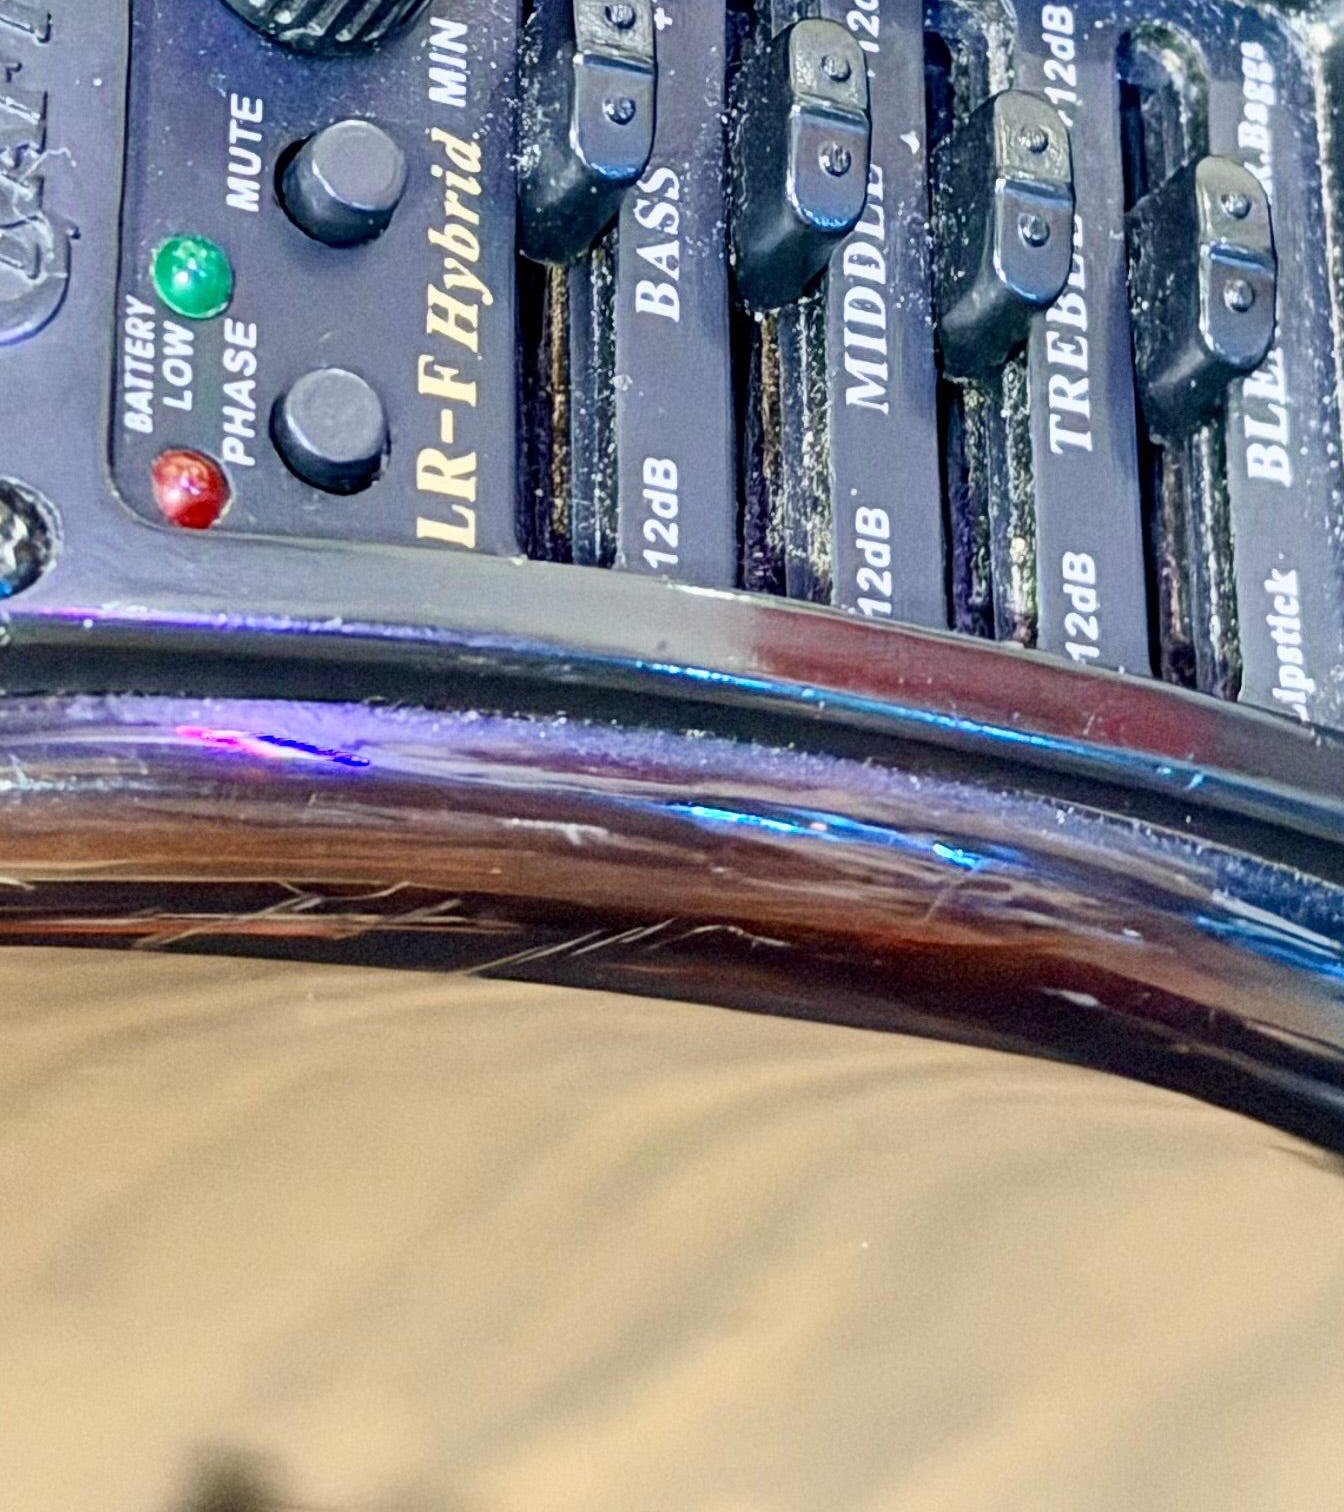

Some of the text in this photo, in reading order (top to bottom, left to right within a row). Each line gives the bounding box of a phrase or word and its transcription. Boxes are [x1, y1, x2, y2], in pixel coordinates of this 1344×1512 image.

[429, 18, 468, 107] MIN
[224, 92, 263, 214] MUTE
[636, 166, 680, 322] BASS
[122, 293, 158, 436] BATTERY
[161, 320, 195, 411] LOW
[219, 318, 258, 467] PHASE
[415, 128, 494, 550] LR-F Hybrid
[1047, 214, 1093, 454] TREB
